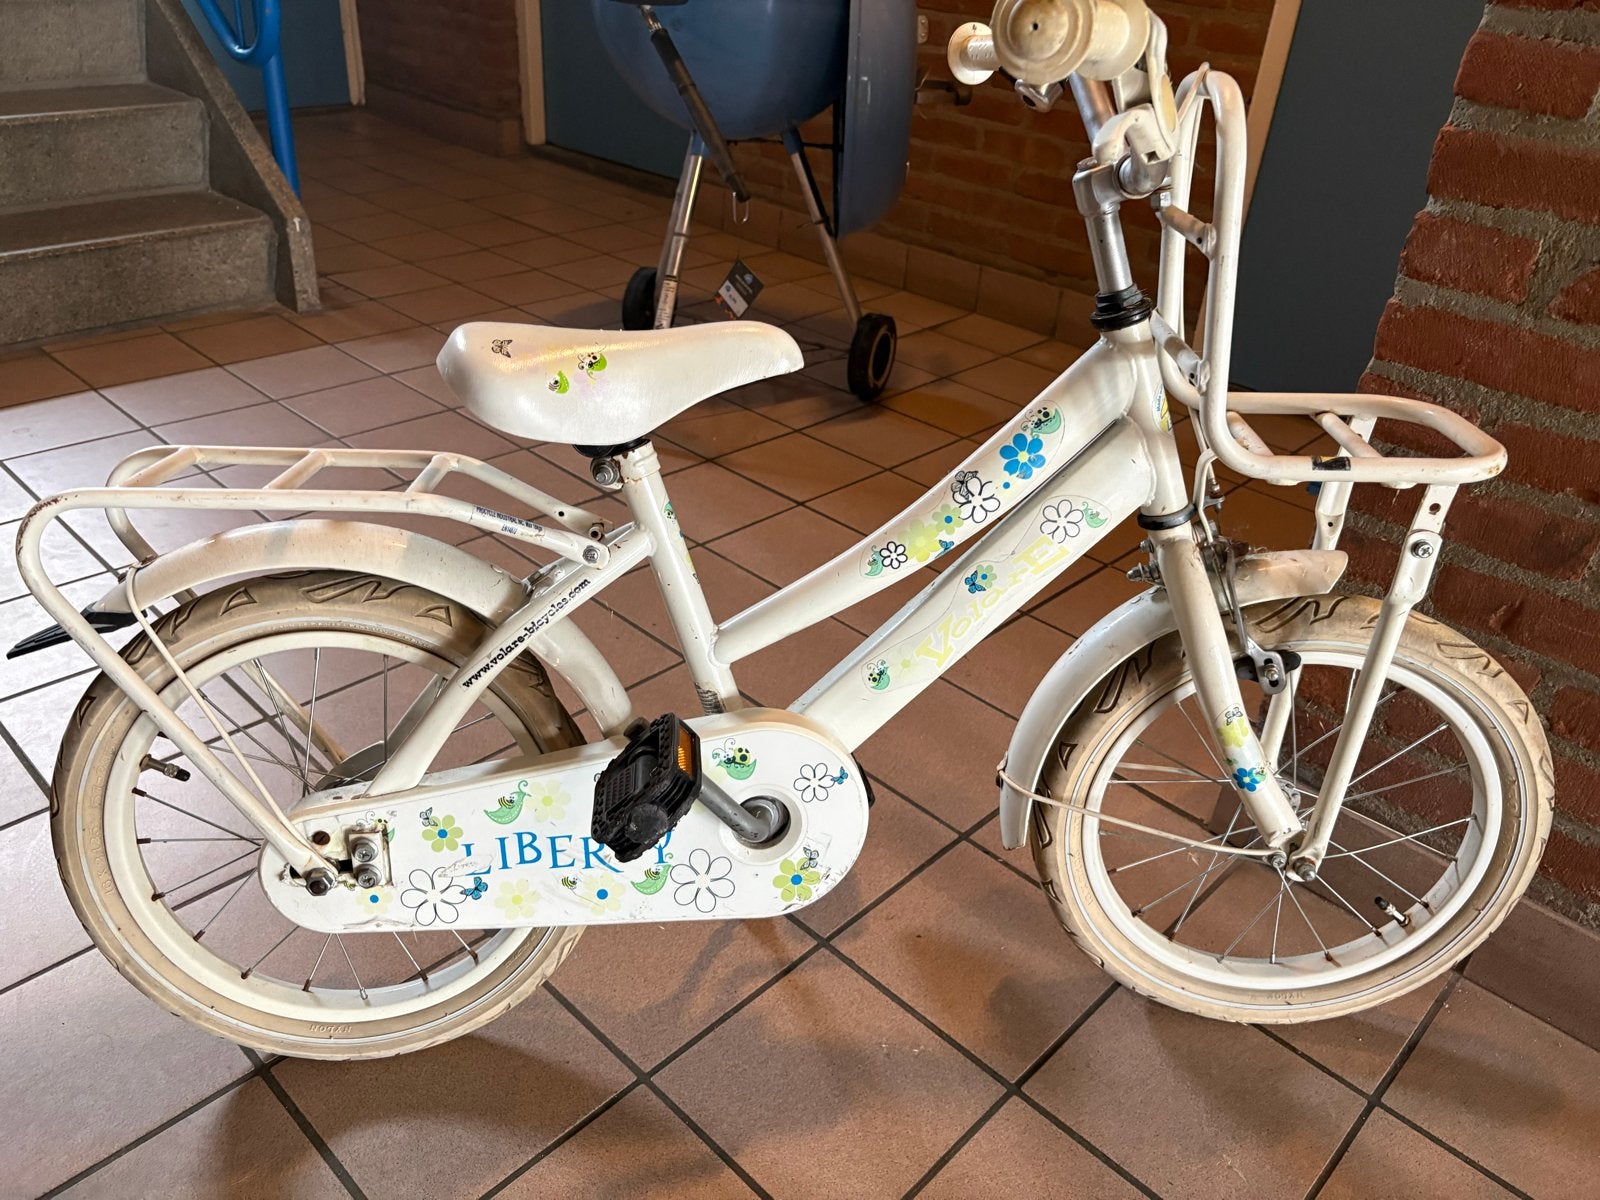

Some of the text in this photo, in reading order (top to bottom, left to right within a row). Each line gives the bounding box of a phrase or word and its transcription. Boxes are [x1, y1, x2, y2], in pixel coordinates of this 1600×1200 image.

[462, 578, 591, 688] www.volare-bicycles.com
[461, 830, 672, 874] LIBERY
[309, 1023, 353, 1034] NYLON
